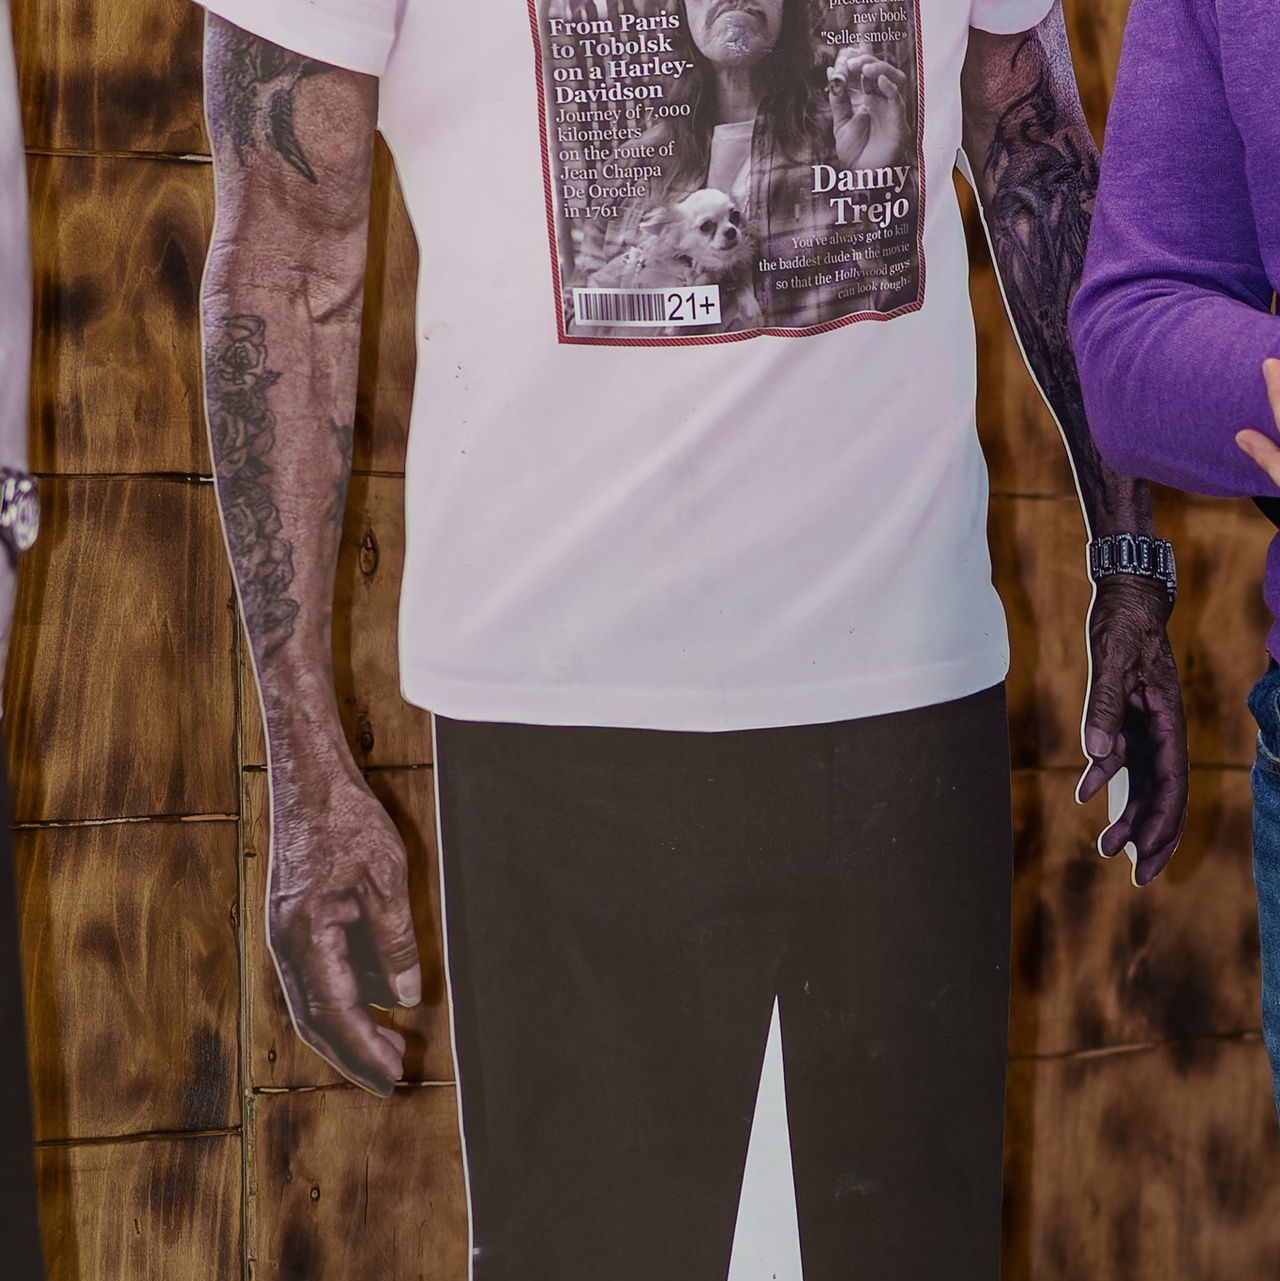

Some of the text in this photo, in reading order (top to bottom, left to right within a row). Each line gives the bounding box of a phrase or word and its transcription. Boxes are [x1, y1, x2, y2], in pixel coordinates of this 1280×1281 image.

[548, 10, 680, 36] From Paris
[853, 7, 908, 24] new book
[551, 33, 674, 59] to Tobolsk
[553, 57, 694, 82] on a Harley-
[554, 82, 664, 104] Davidson
[556, 103, 691, 124] Journey of 7,000
[558, 126, 642, 142] kilometers
[559, 140, 676, 161] on the route of
[560, 164, 662, 181] Jean Chappa
[811, 164, 911, 194] Danny
[563, 182, 646, 199] De Oroche
[564, 203, 618, 220] in 1761
[830, 192, 910, 228] Trejo
[792, 222, 909, 250] You've always got to kill
[758, 241, 910, 272] the baddest dude in the movie
[776, 259, 911, 290] so that the Hollywood guys
[838, 288, 856, 299] can
[857, 282, 878, 294] look
[667, 292, 715, 320] 21+
